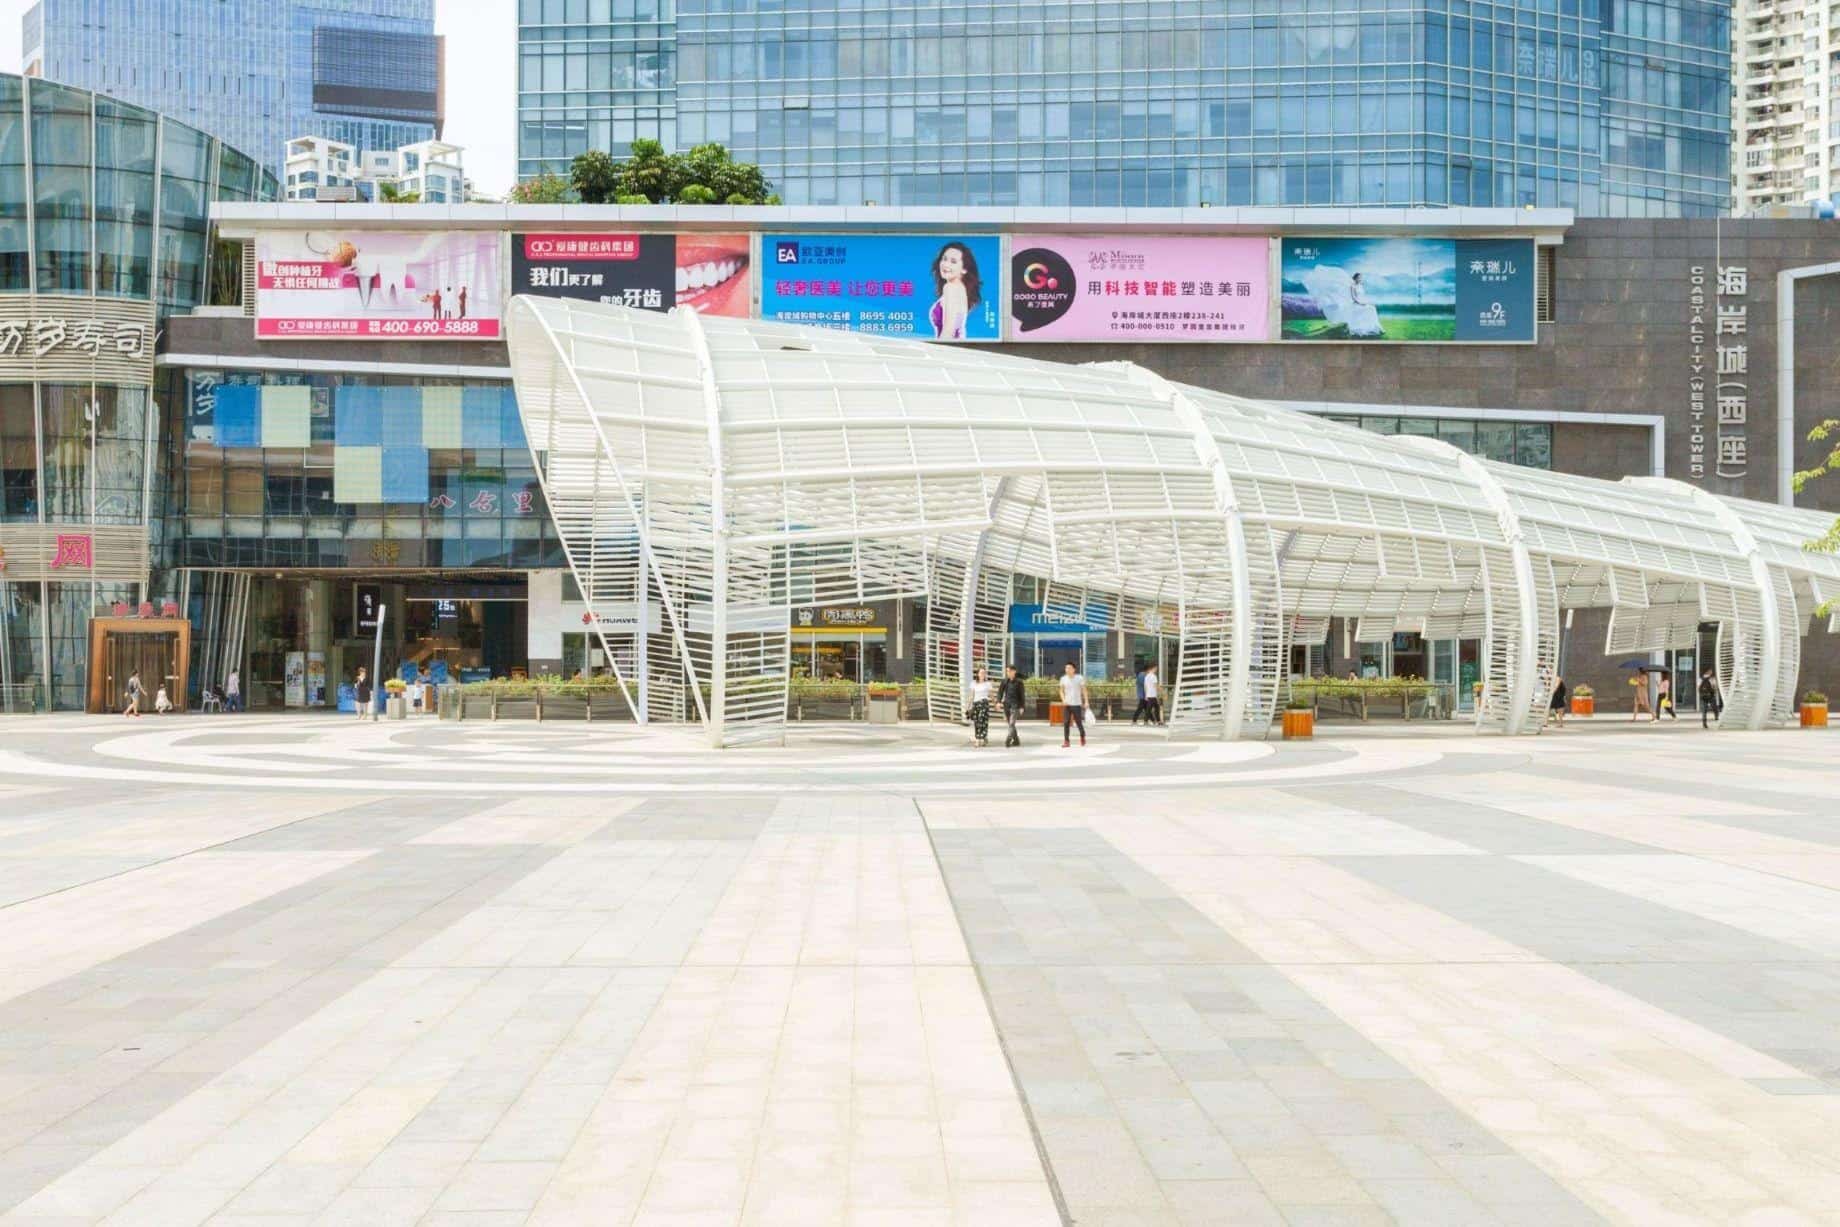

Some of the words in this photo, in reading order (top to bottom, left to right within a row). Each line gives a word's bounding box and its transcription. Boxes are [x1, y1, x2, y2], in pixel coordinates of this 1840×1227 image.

[778, 248, 797, 262] EA
[1088, 280, 1251, 297] 用科技智能塑造美丽
[859, 311, 885, 321] 8695
[887, 311, 914, 321] 4003
